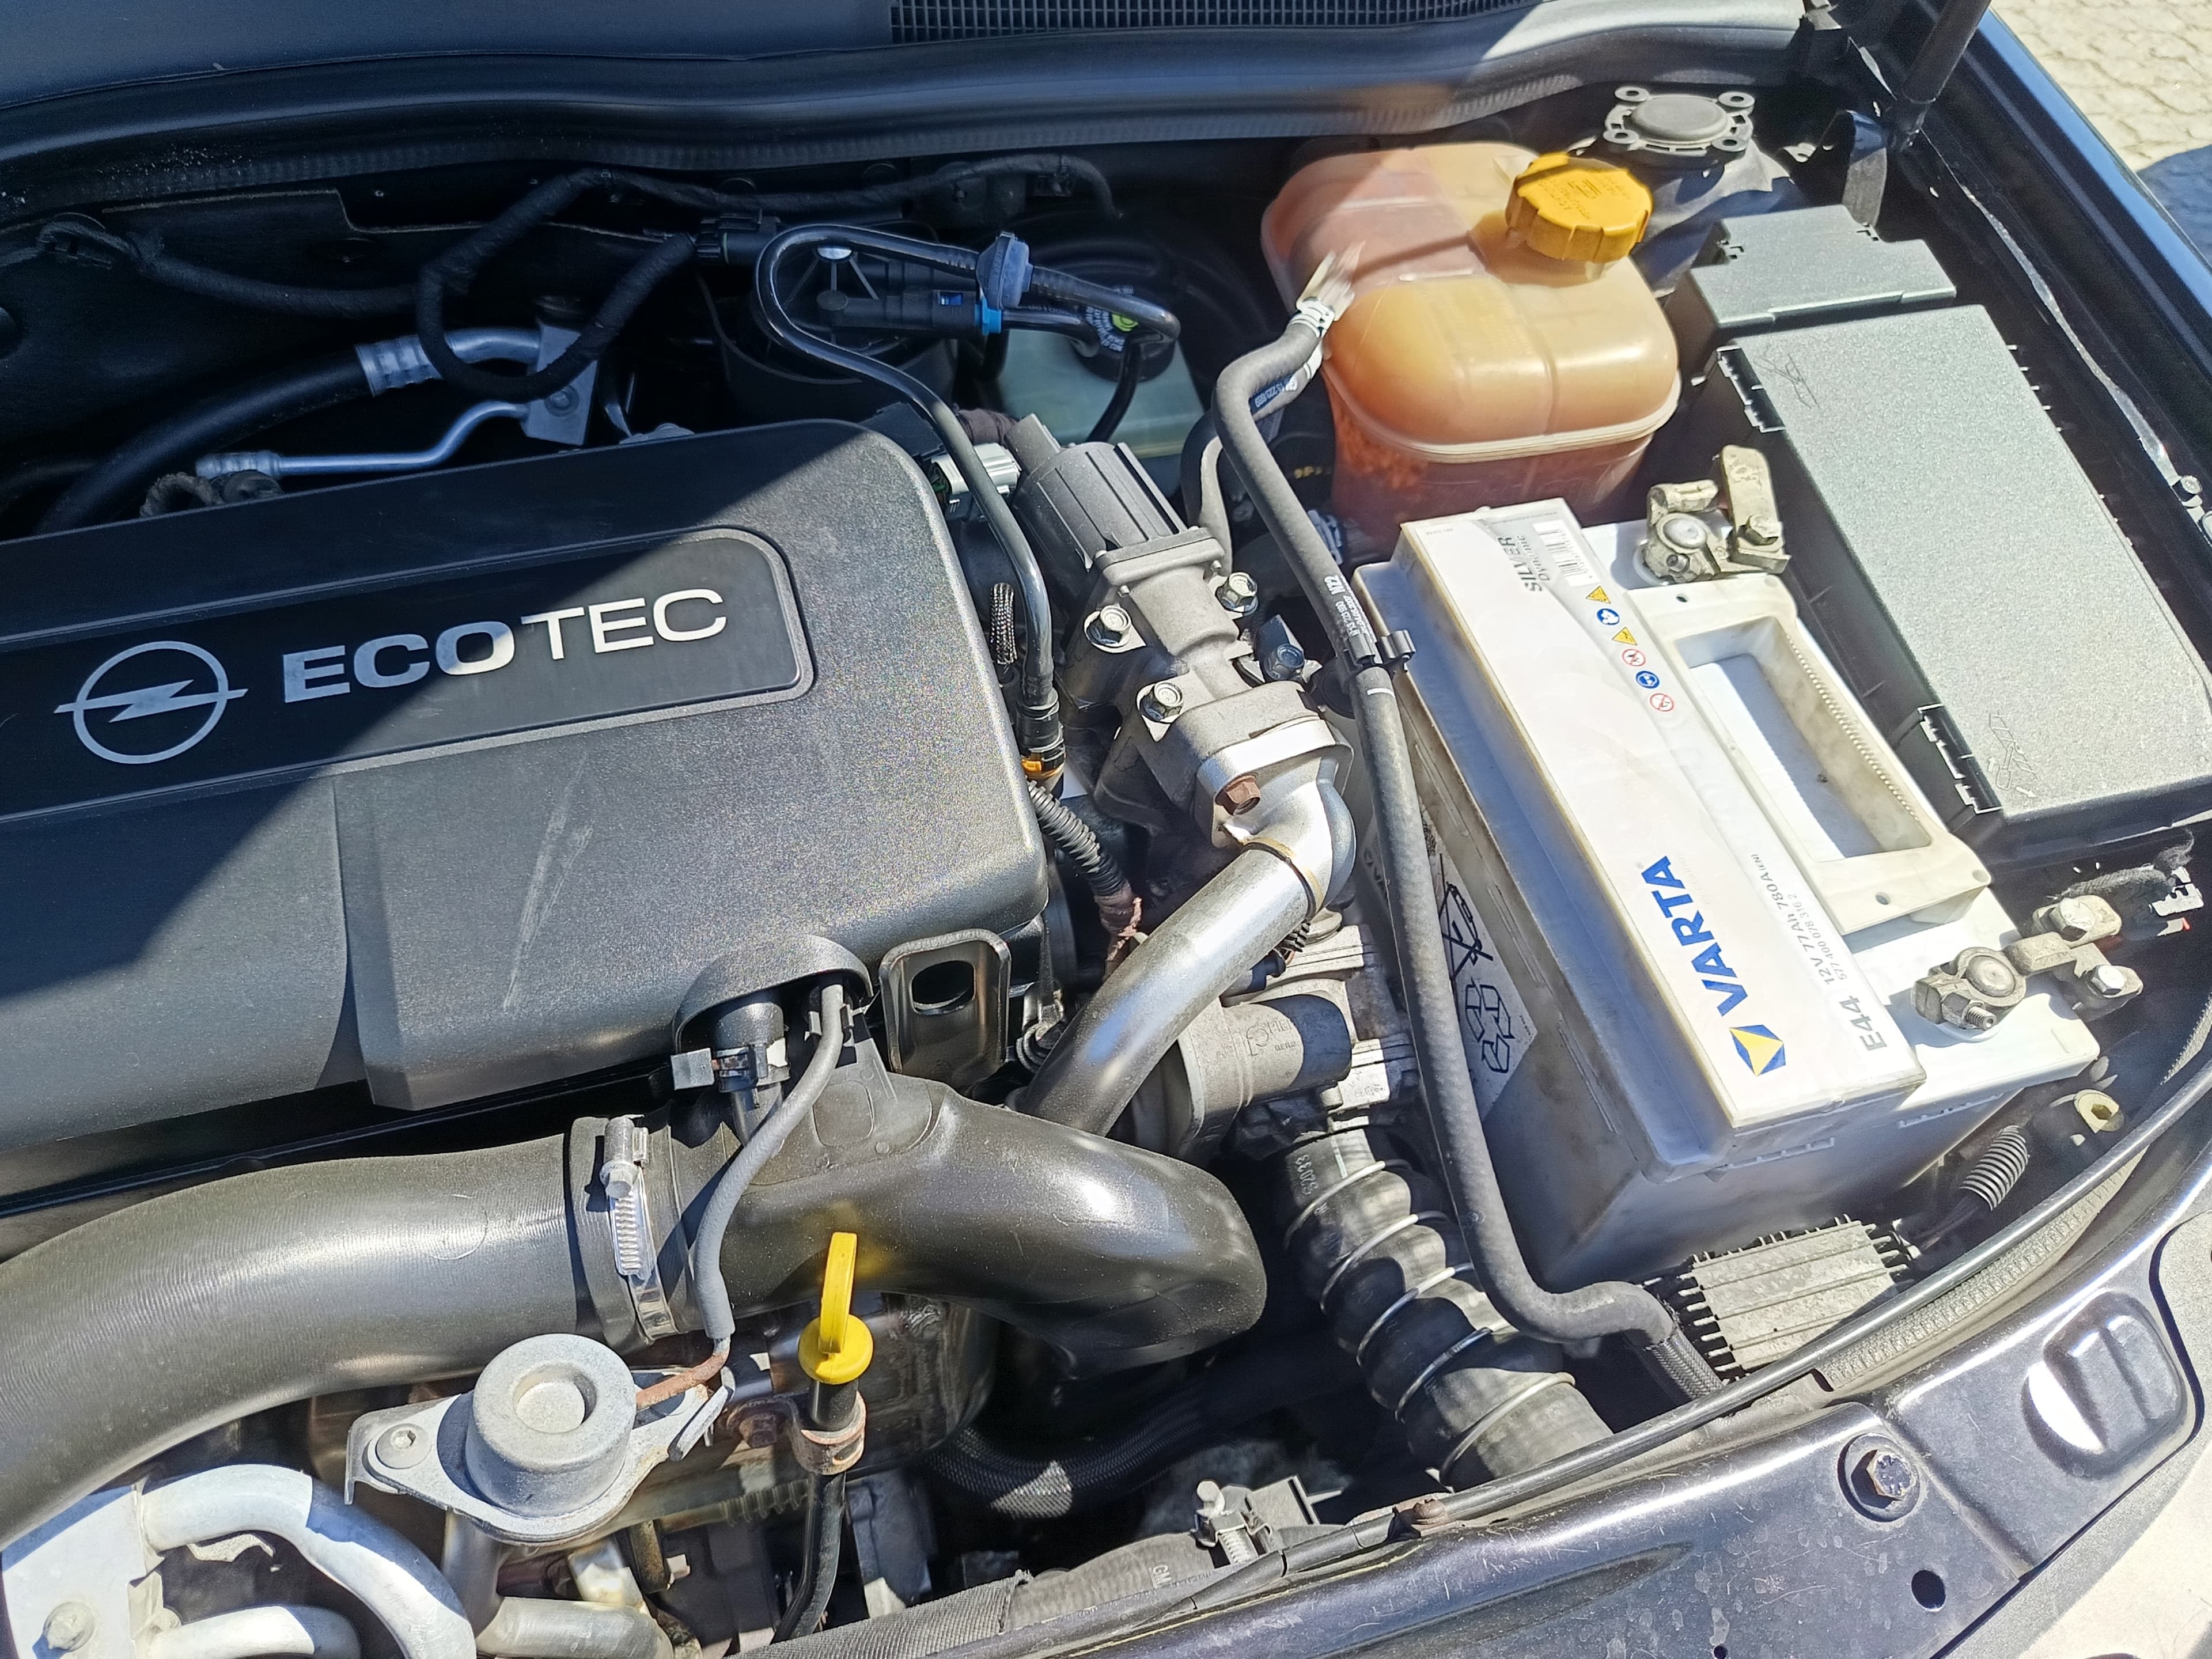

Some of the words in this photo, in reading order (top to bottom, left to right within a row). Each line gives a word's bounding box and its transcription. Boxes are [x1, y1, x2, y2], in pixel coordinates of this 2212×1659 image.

[1498, 536, 1543, 593] SILVER
[1517, 535, 1550, 581] Dynamic
[283, 588, 728, 703] ECOTEC
[1792, 900, 1810, 920] 316
[1804, 920, 1821, 939] 078
[1641, 855, 1748, 1017] VARTA
[1786, 913, 1815, 952] 77Ah
[1817, 940, 1834, 959] 400
[1810, 957, 1835, 985] 12V
[1830, 961, 1847, 980] 577
[1839, 995, 1888, 1051] E44
